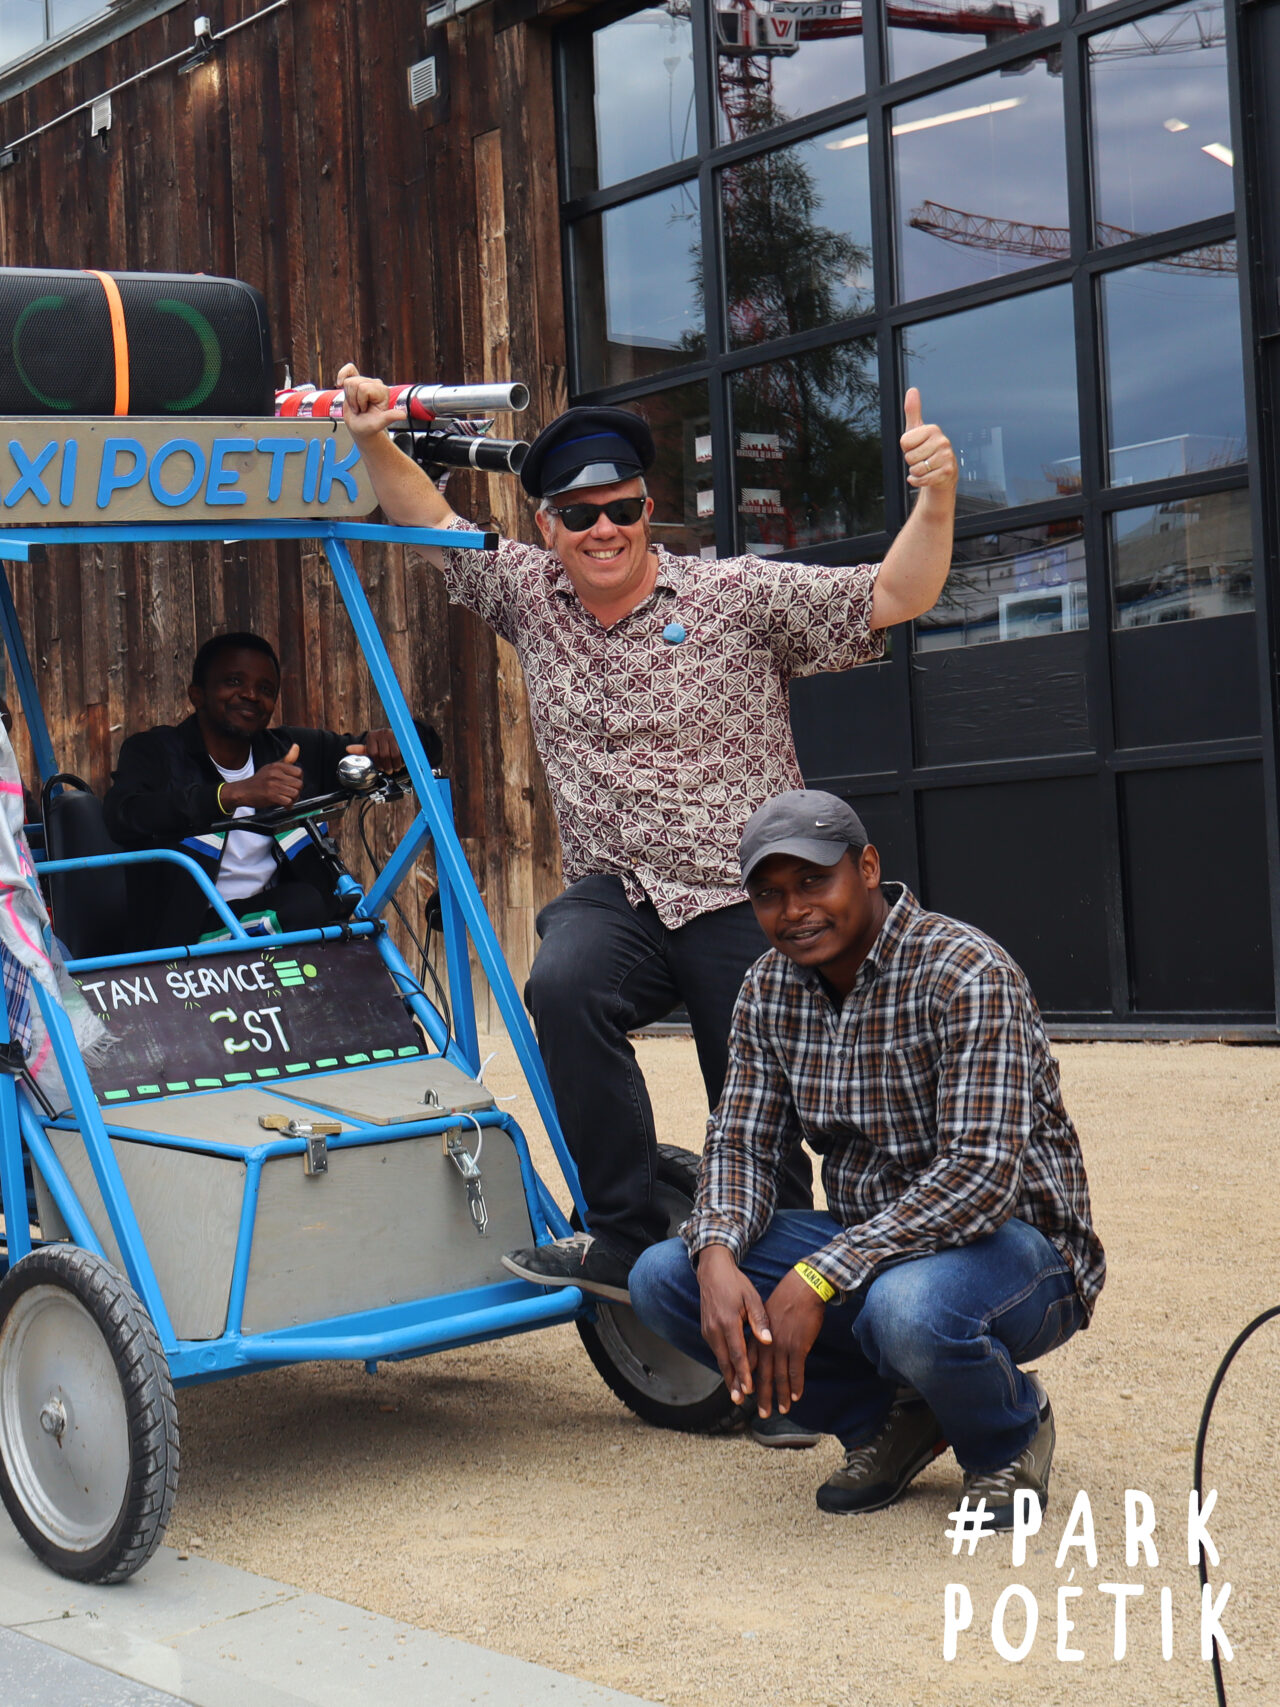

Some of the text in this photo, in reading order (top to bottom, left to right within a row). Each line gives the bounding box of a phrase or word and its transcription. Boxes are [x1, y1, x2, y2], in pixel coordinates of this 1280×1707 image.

[96, 437, 360, 508] POETIK
[81, 961, 275, 1012] TAXI SERVICE
[803, 1266, 824, 1290] KANAL
